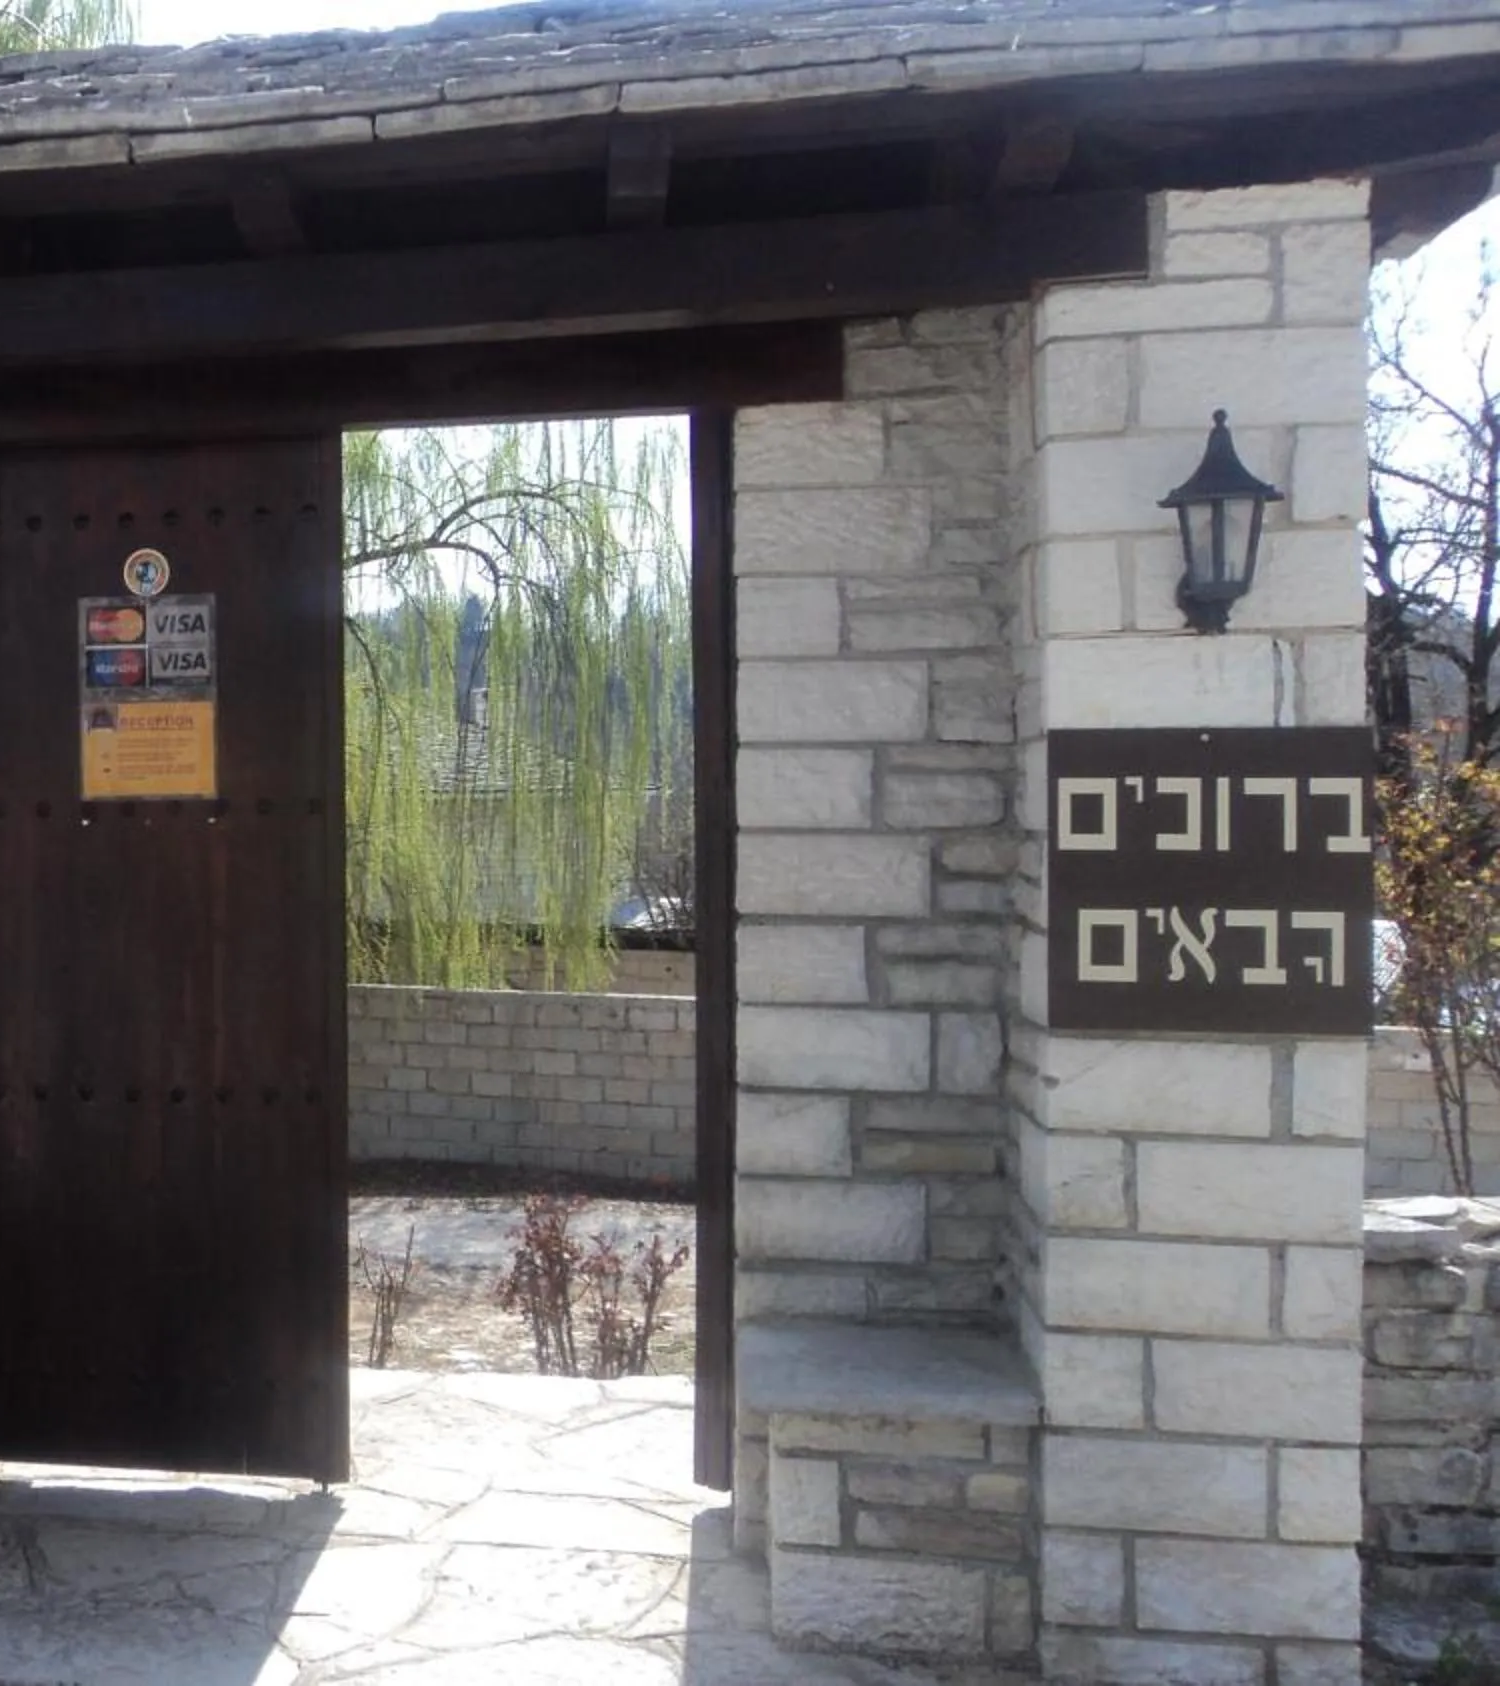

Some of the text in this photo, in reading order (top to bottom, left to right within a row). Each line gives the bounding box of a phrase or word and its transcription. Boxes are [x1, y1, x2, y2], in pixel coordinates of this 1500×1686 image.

[155, 613, 206, 634] VISA
[157, 652, 206, 671] VISA
[1057, 775, 1372, 853] ברוכים
[1077, 905, 1346, 988] הבאים
